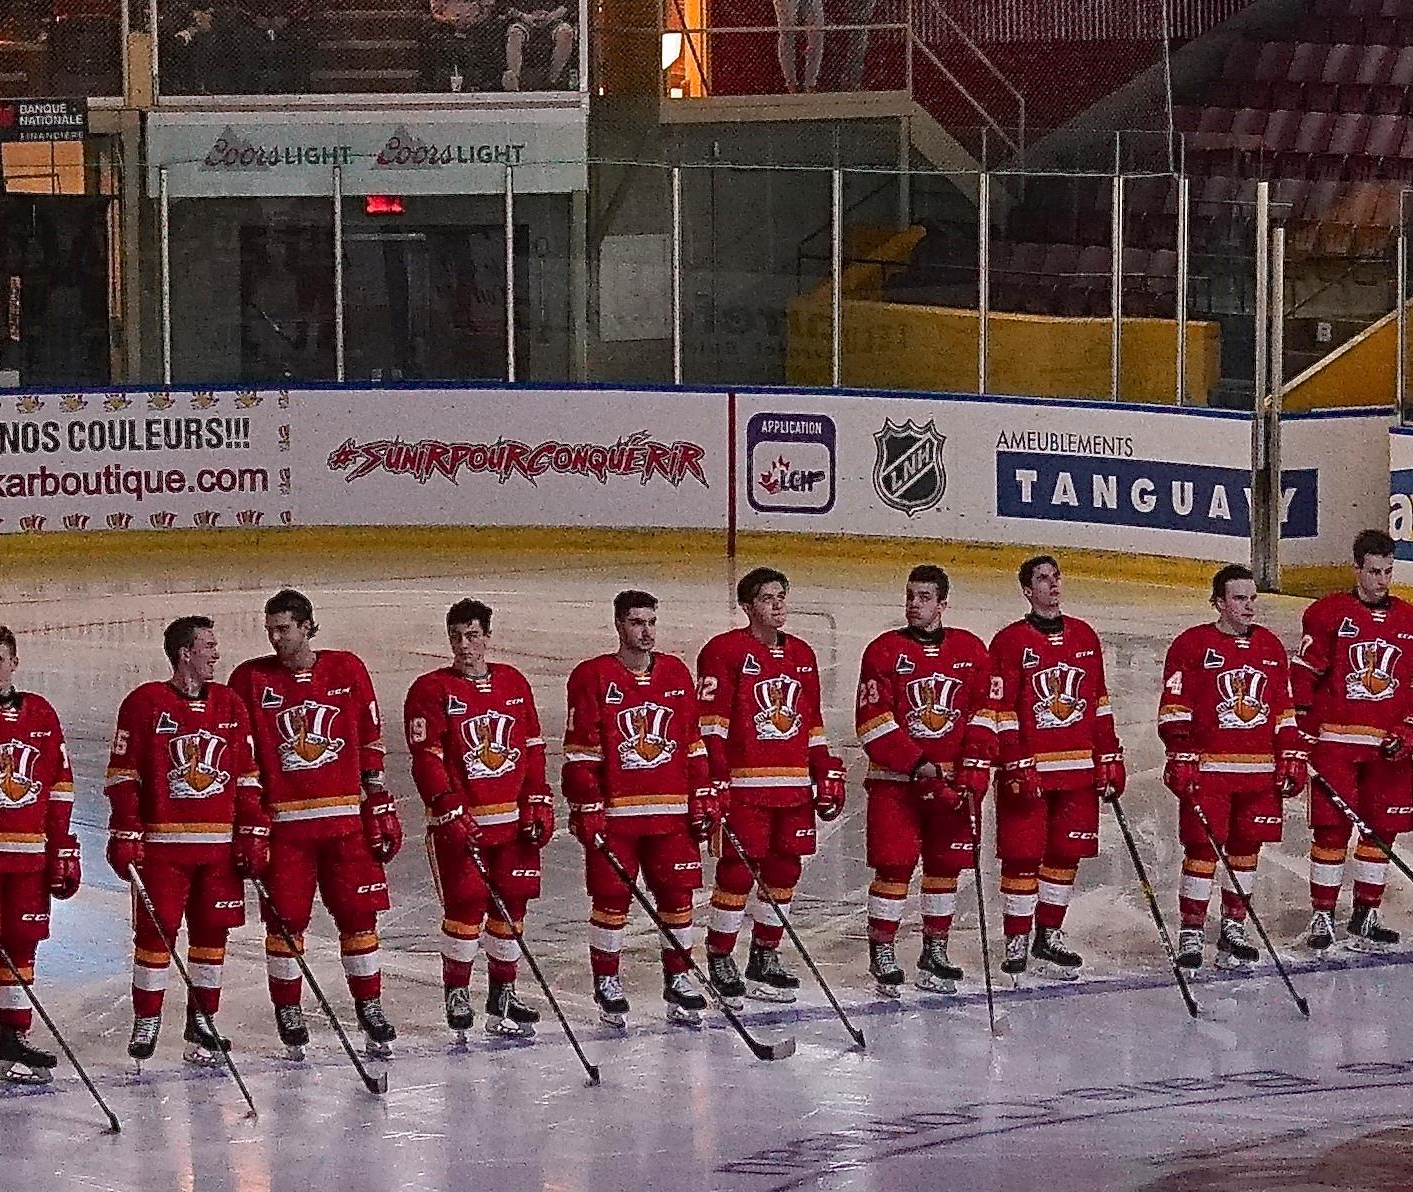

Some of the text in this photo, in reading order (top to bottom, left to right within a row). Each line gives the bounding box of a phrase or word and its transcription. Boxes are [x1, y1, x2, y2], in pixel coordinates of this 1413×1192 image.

[20, 104, 67, 114] BANQUE
[19, 114, 83, 126] NATIONALE
[204, 137, 352, 167] Coors LIGHT
[375, 136, 525, 166] Coors LIGHT
[1316, 322, 1333, 344] B
[69, 416, 250, 452] COULEURS!!!
[761, 420, 822, 435] APPLICATION
[996, 430, 1134, 458] AMEUBLEMENTS
[888, 440, 933, 492] LNH
[1166, 670, 1183, 696] 4
[795, 828, 816, 837] CC
[57, 848, 82, 858] CC
[949, 842, 975, 851] CC
[511, 868, 541, 877] CC
[21, 912, 51, 922] CC
